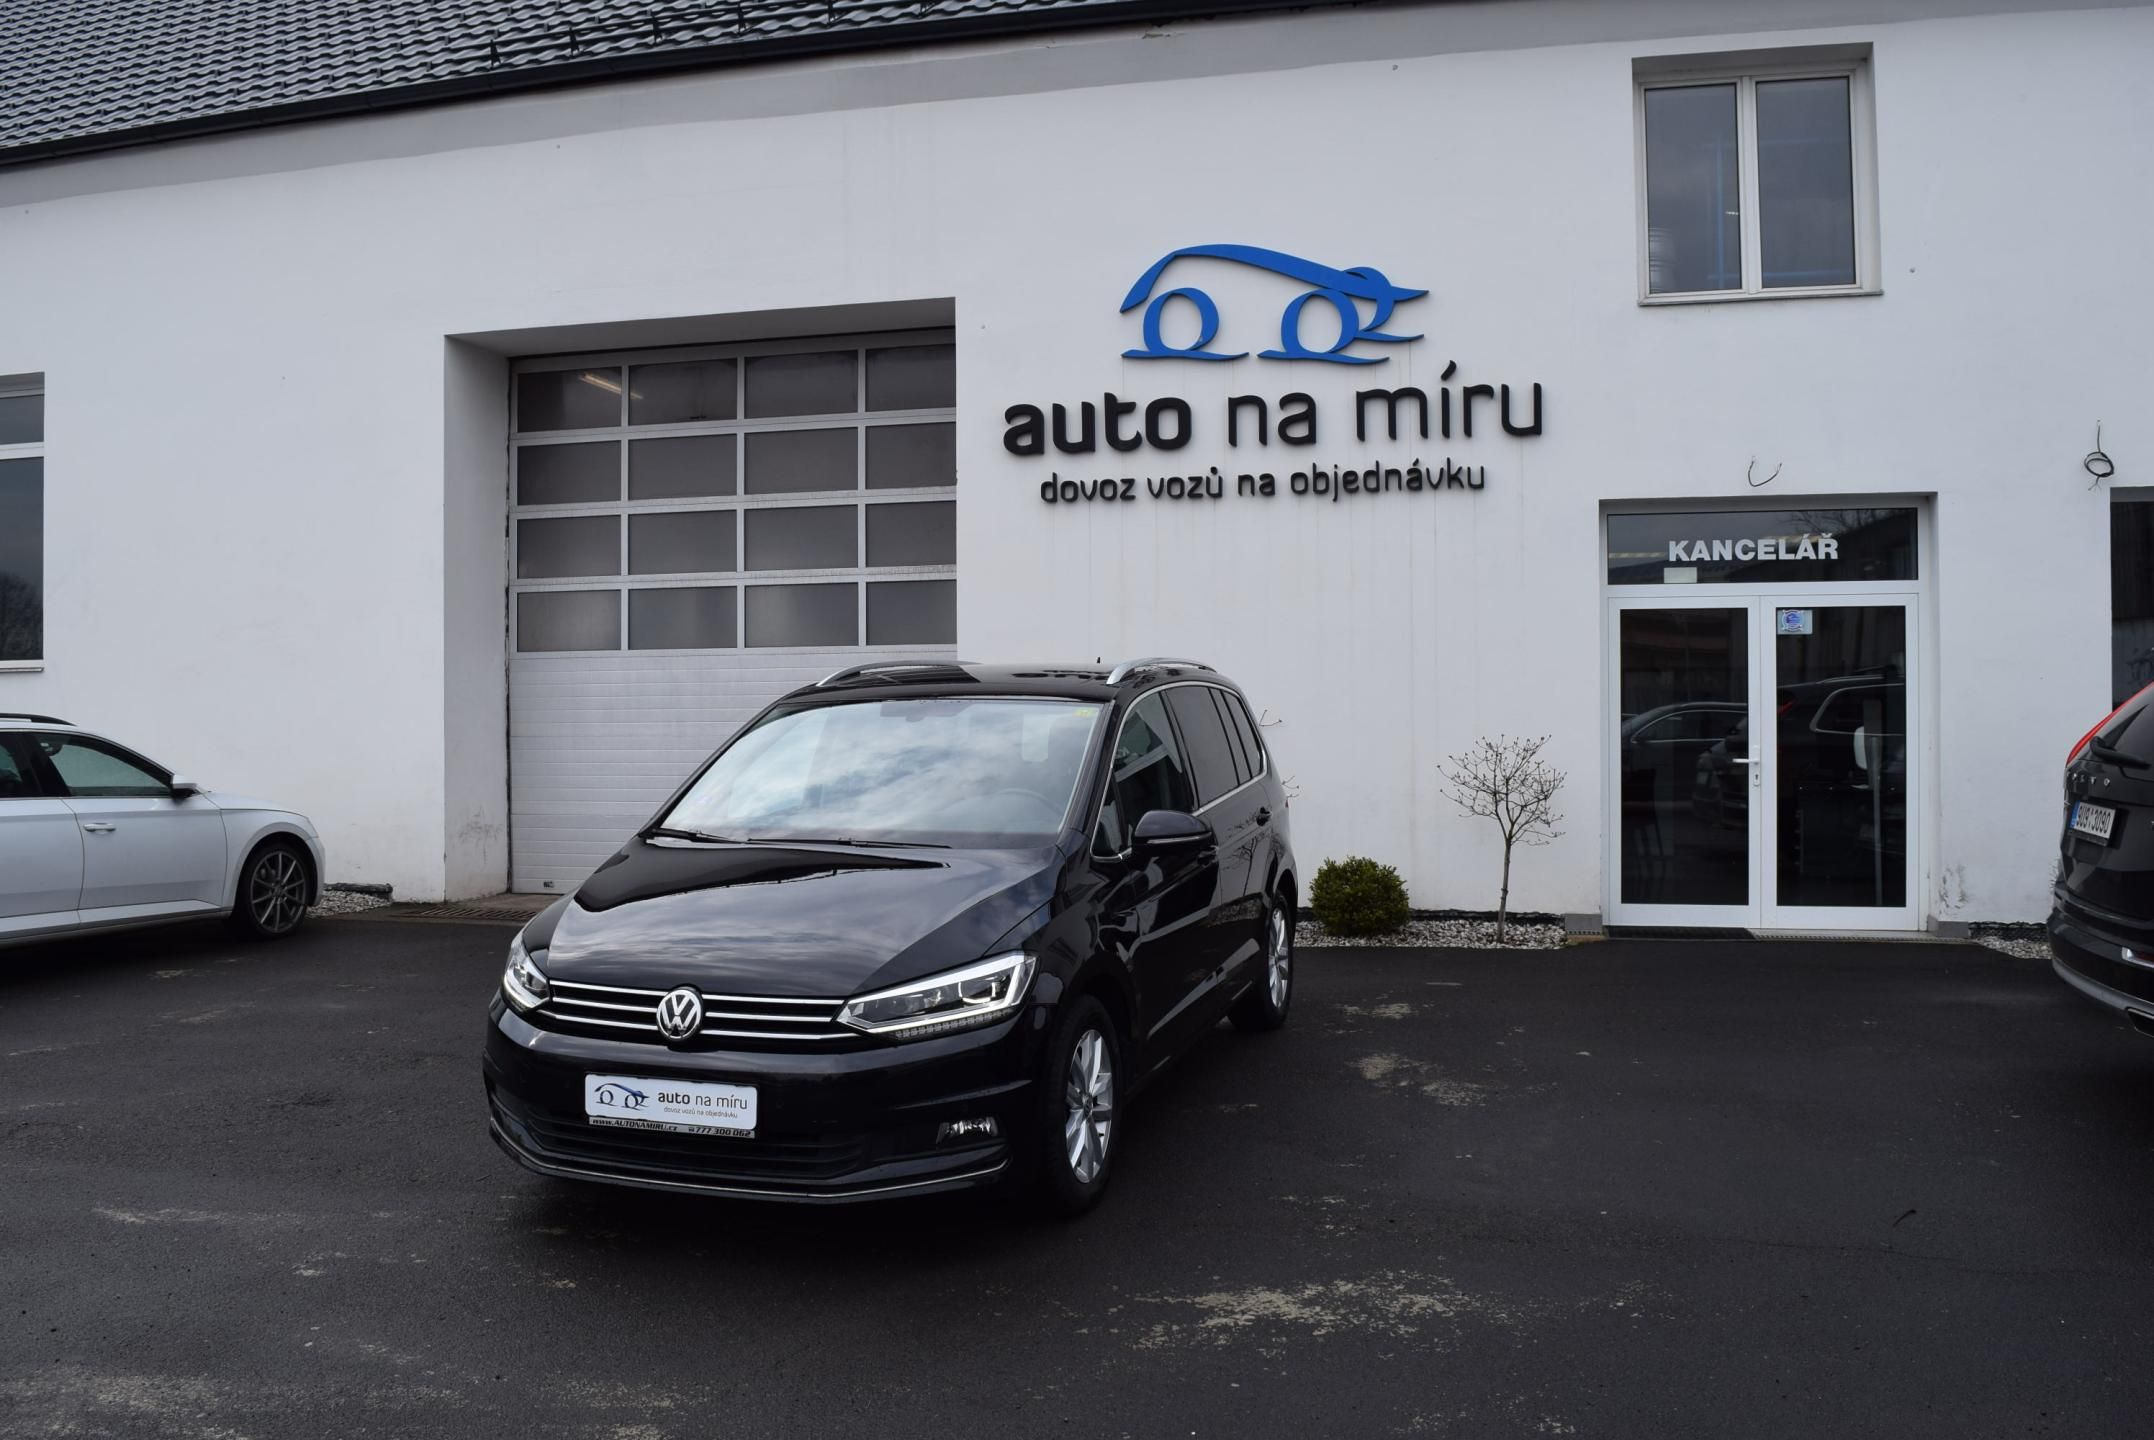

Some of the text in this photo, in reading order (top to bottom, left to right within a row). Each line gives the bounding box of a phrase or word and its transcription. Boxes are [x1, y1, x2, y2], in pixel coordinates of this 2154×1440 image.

[1003, 359, 1542, 456] auto na míru
[1040, 458, 1485, 502] dovoz vozů na objednávku
[1668, 532, 1838, 562] KANCELÁŘ
[657, 1092, 748, 1110] auto na míru
[663, 1106, 681, 1114] dovoz
[705, 1110, 738, 1119] objednávku
[696, 1126, 712, 1134] 777
